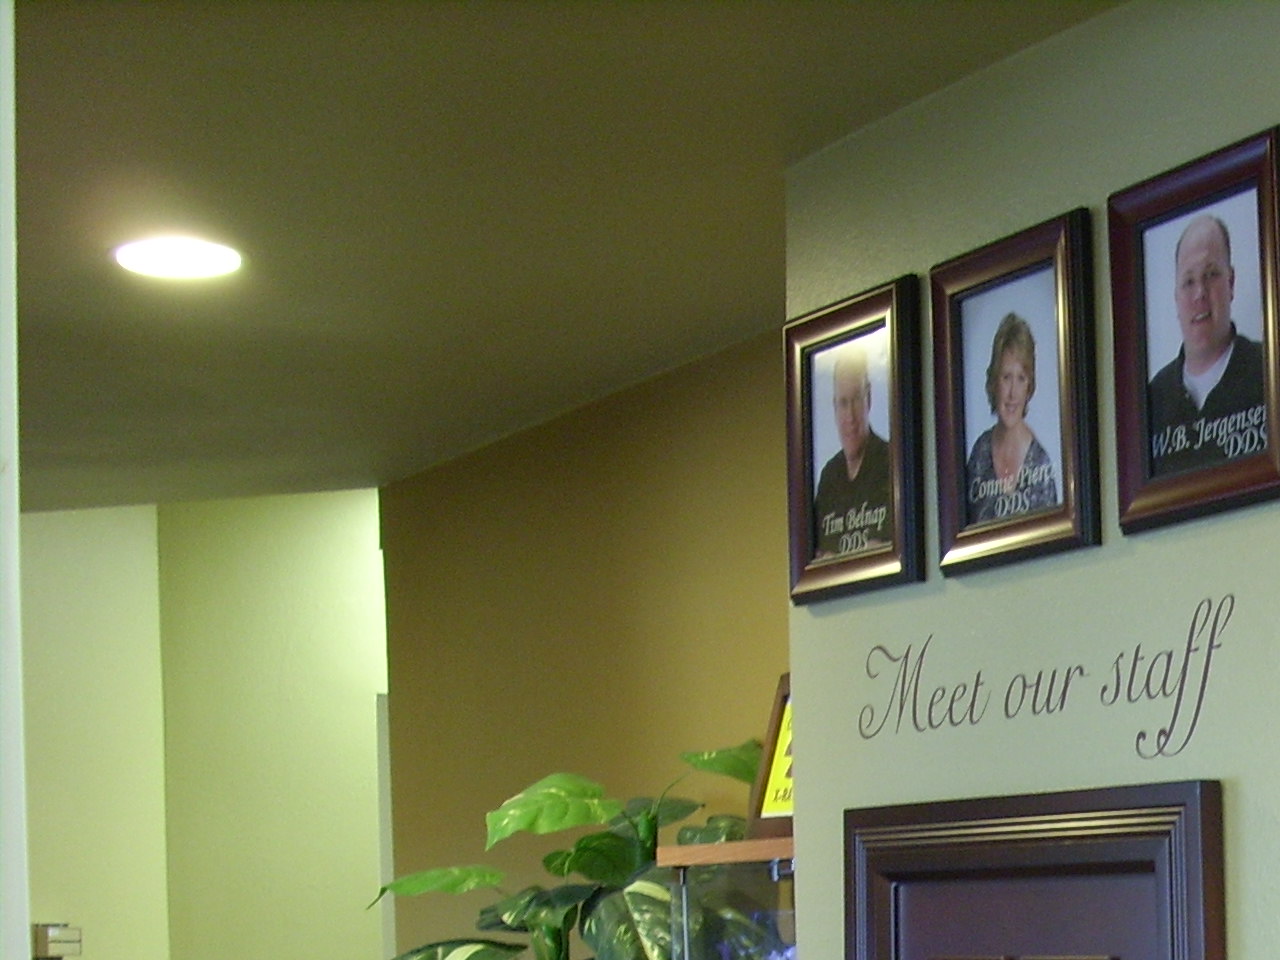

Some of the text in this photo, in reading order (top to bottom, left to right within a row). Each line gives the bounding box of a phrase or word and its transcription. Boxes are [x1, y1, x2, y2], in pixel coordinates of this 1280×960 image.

[1018, 461, 1056, 489] Pierc
[822, 511, 845, 535] Tim
[859, 593, 1235, 759] Meet our staff
